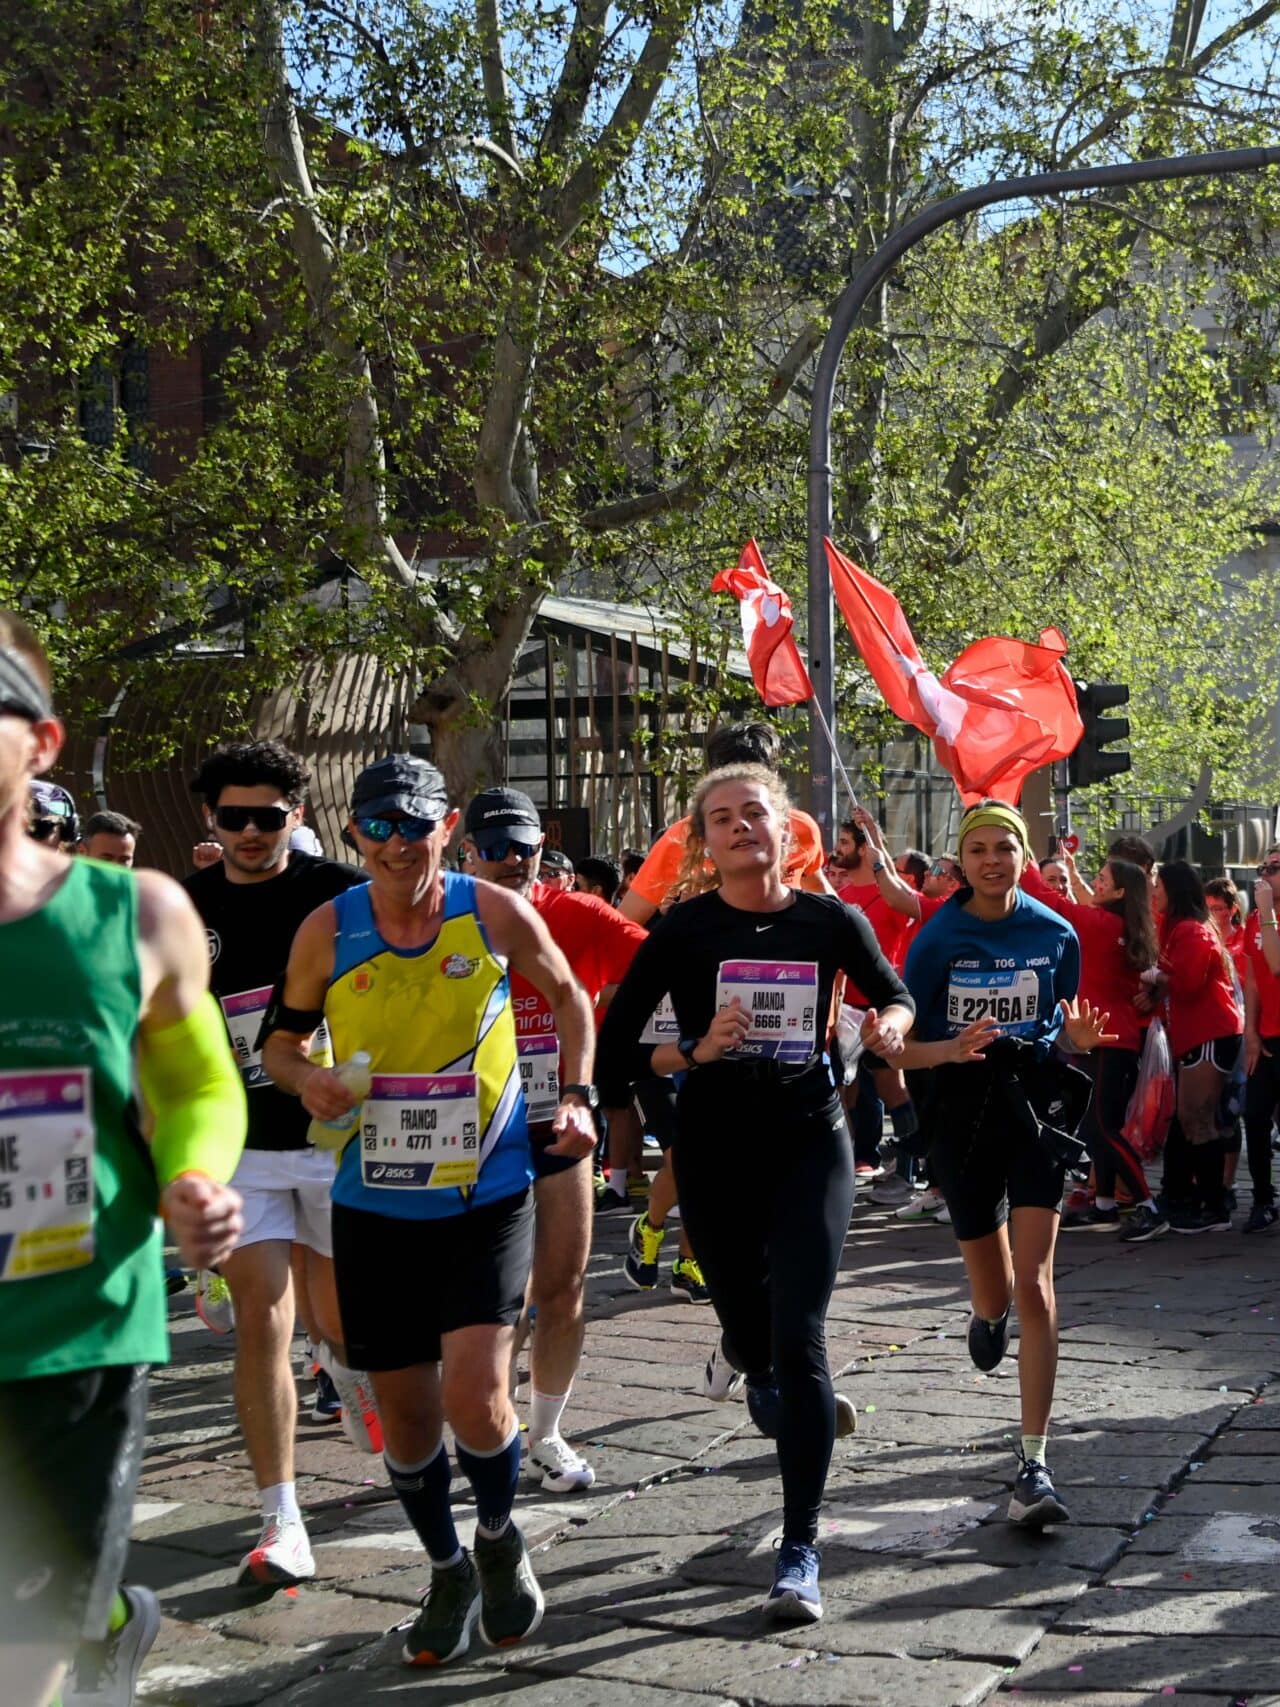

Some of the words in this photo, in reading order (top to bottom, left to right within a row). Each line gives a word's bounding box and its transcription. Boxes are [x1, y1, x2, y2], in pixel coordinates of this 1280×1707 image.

[994, 959, 1015, 969] TOG
[752, 992, 785, 1011] AMANDA
[962, 997, 1021, 1023] 2216A
[754, 1015, 781, 1029] 6666
[400, 1109, 437, 1131] FRANCO
[406, 1135, 432, 1151] 4771
[385, 1167, 416, 1178] asics
